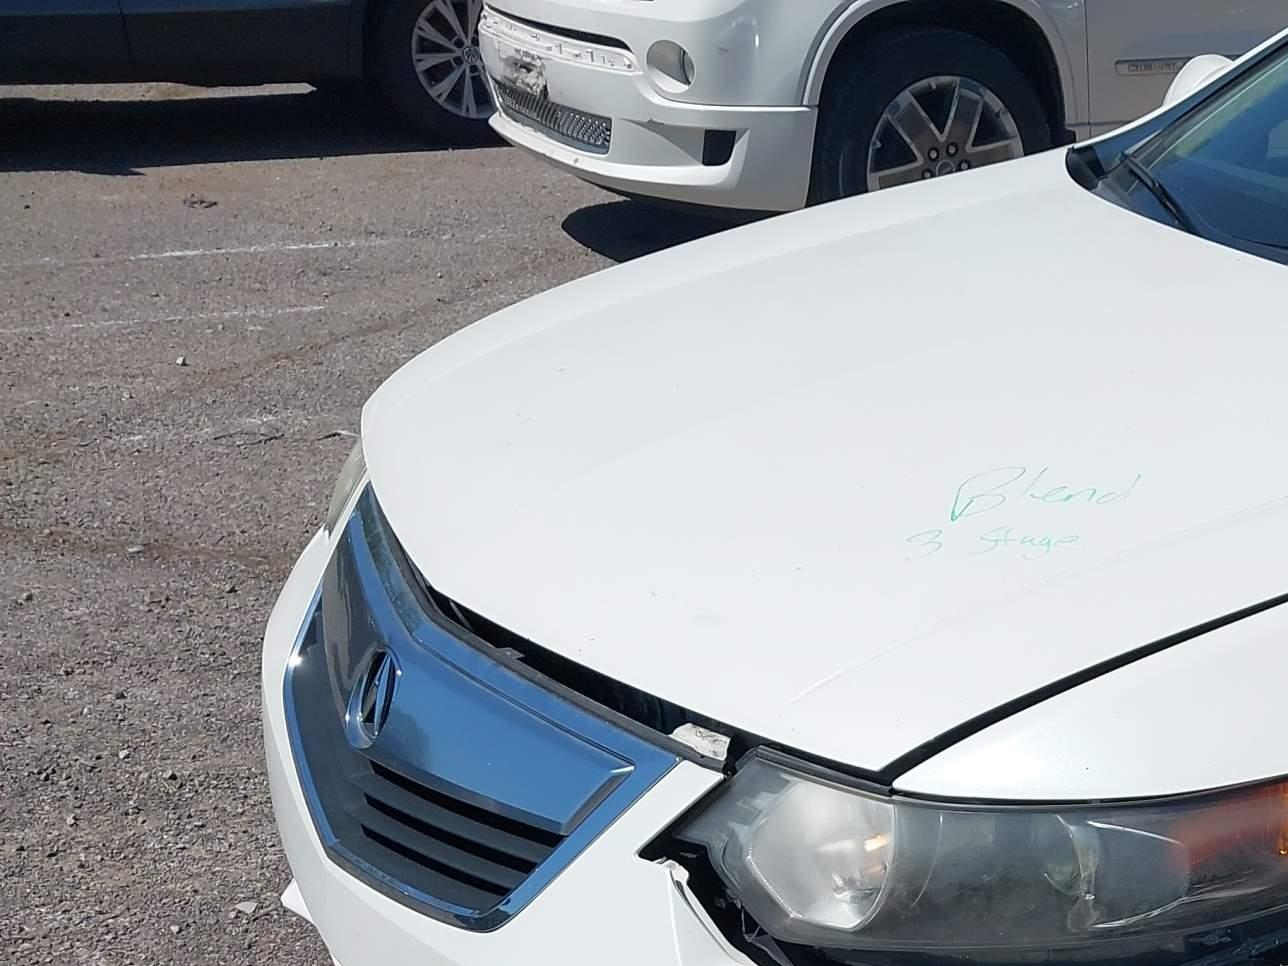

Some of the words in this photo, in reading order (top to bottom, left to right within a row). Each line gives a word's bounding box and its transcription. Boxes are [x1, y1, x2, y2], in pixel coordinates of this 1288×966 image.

[950, 466, 1142, 522] Blend
[904, 529, 944, 561] 3
[967, 526, 1080, 561] Stage
